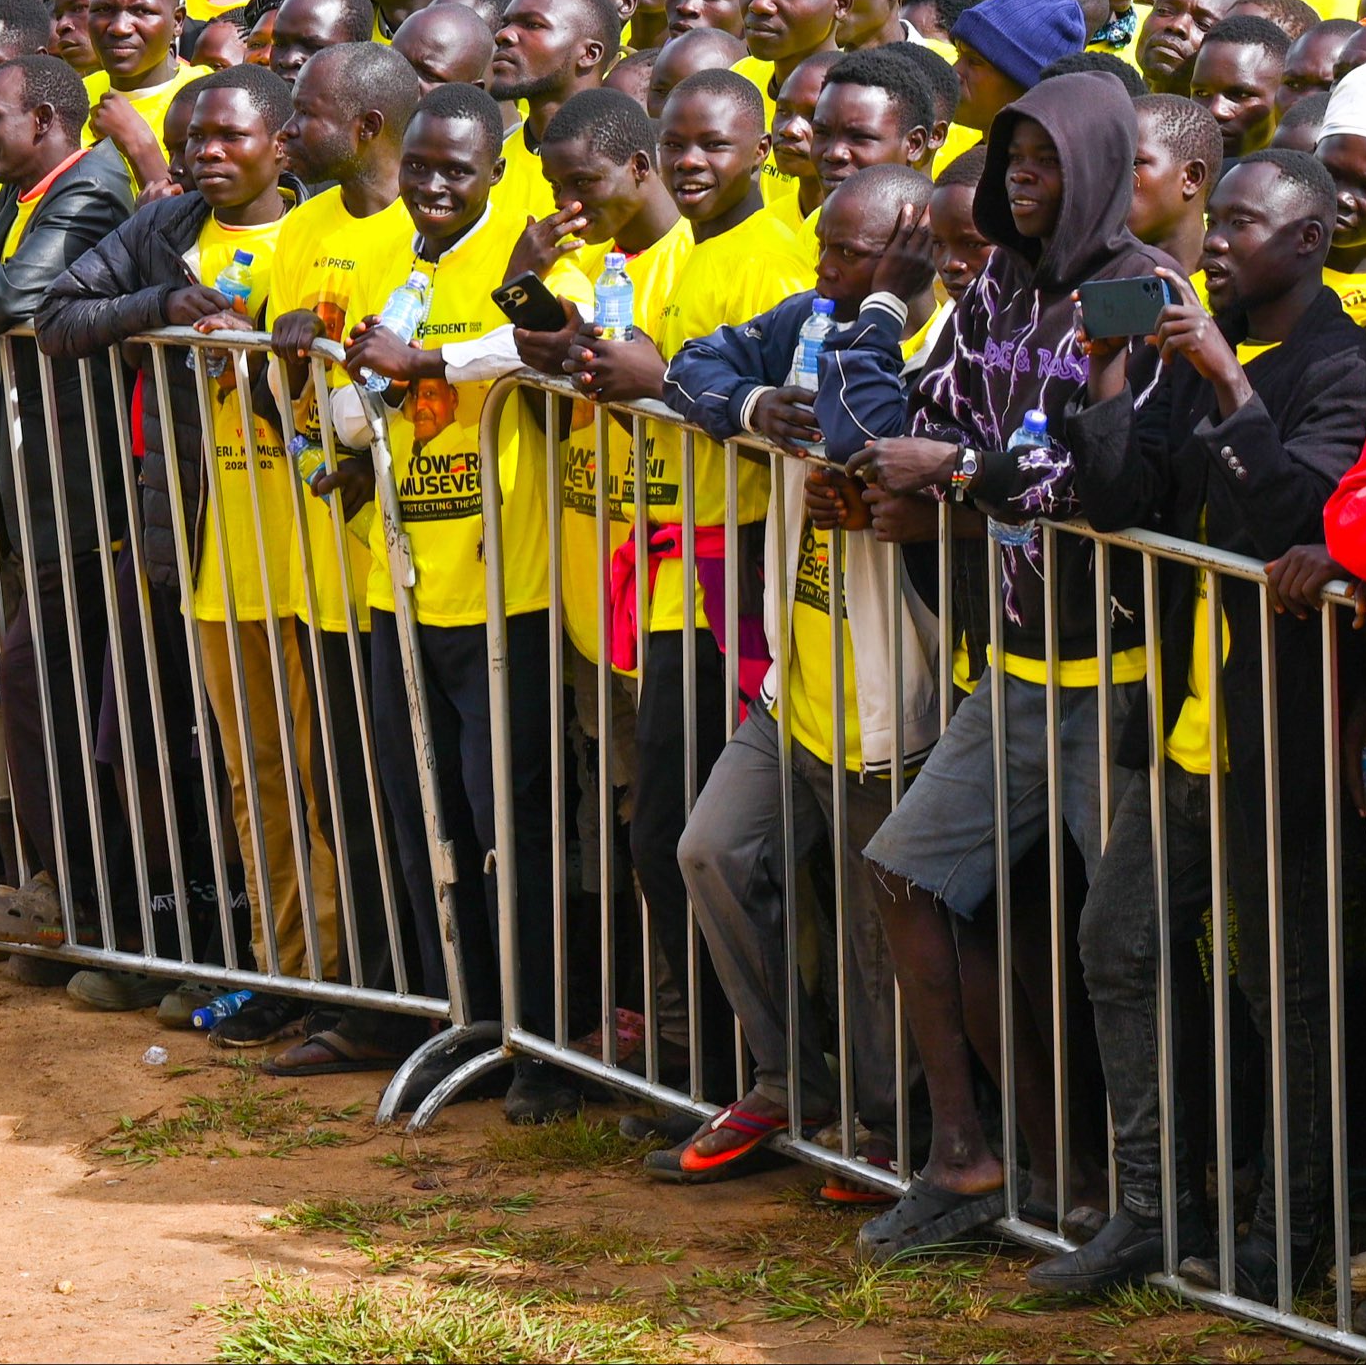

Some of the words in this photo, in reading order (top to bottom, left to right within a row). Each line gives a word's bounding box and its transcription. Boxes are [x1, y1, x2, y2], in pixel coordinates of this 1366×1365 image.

[327, 257, 356, 271] PRESI
[236, 428, 266, 438] VTE
[400, 472, 482, 497] MUSEVE
